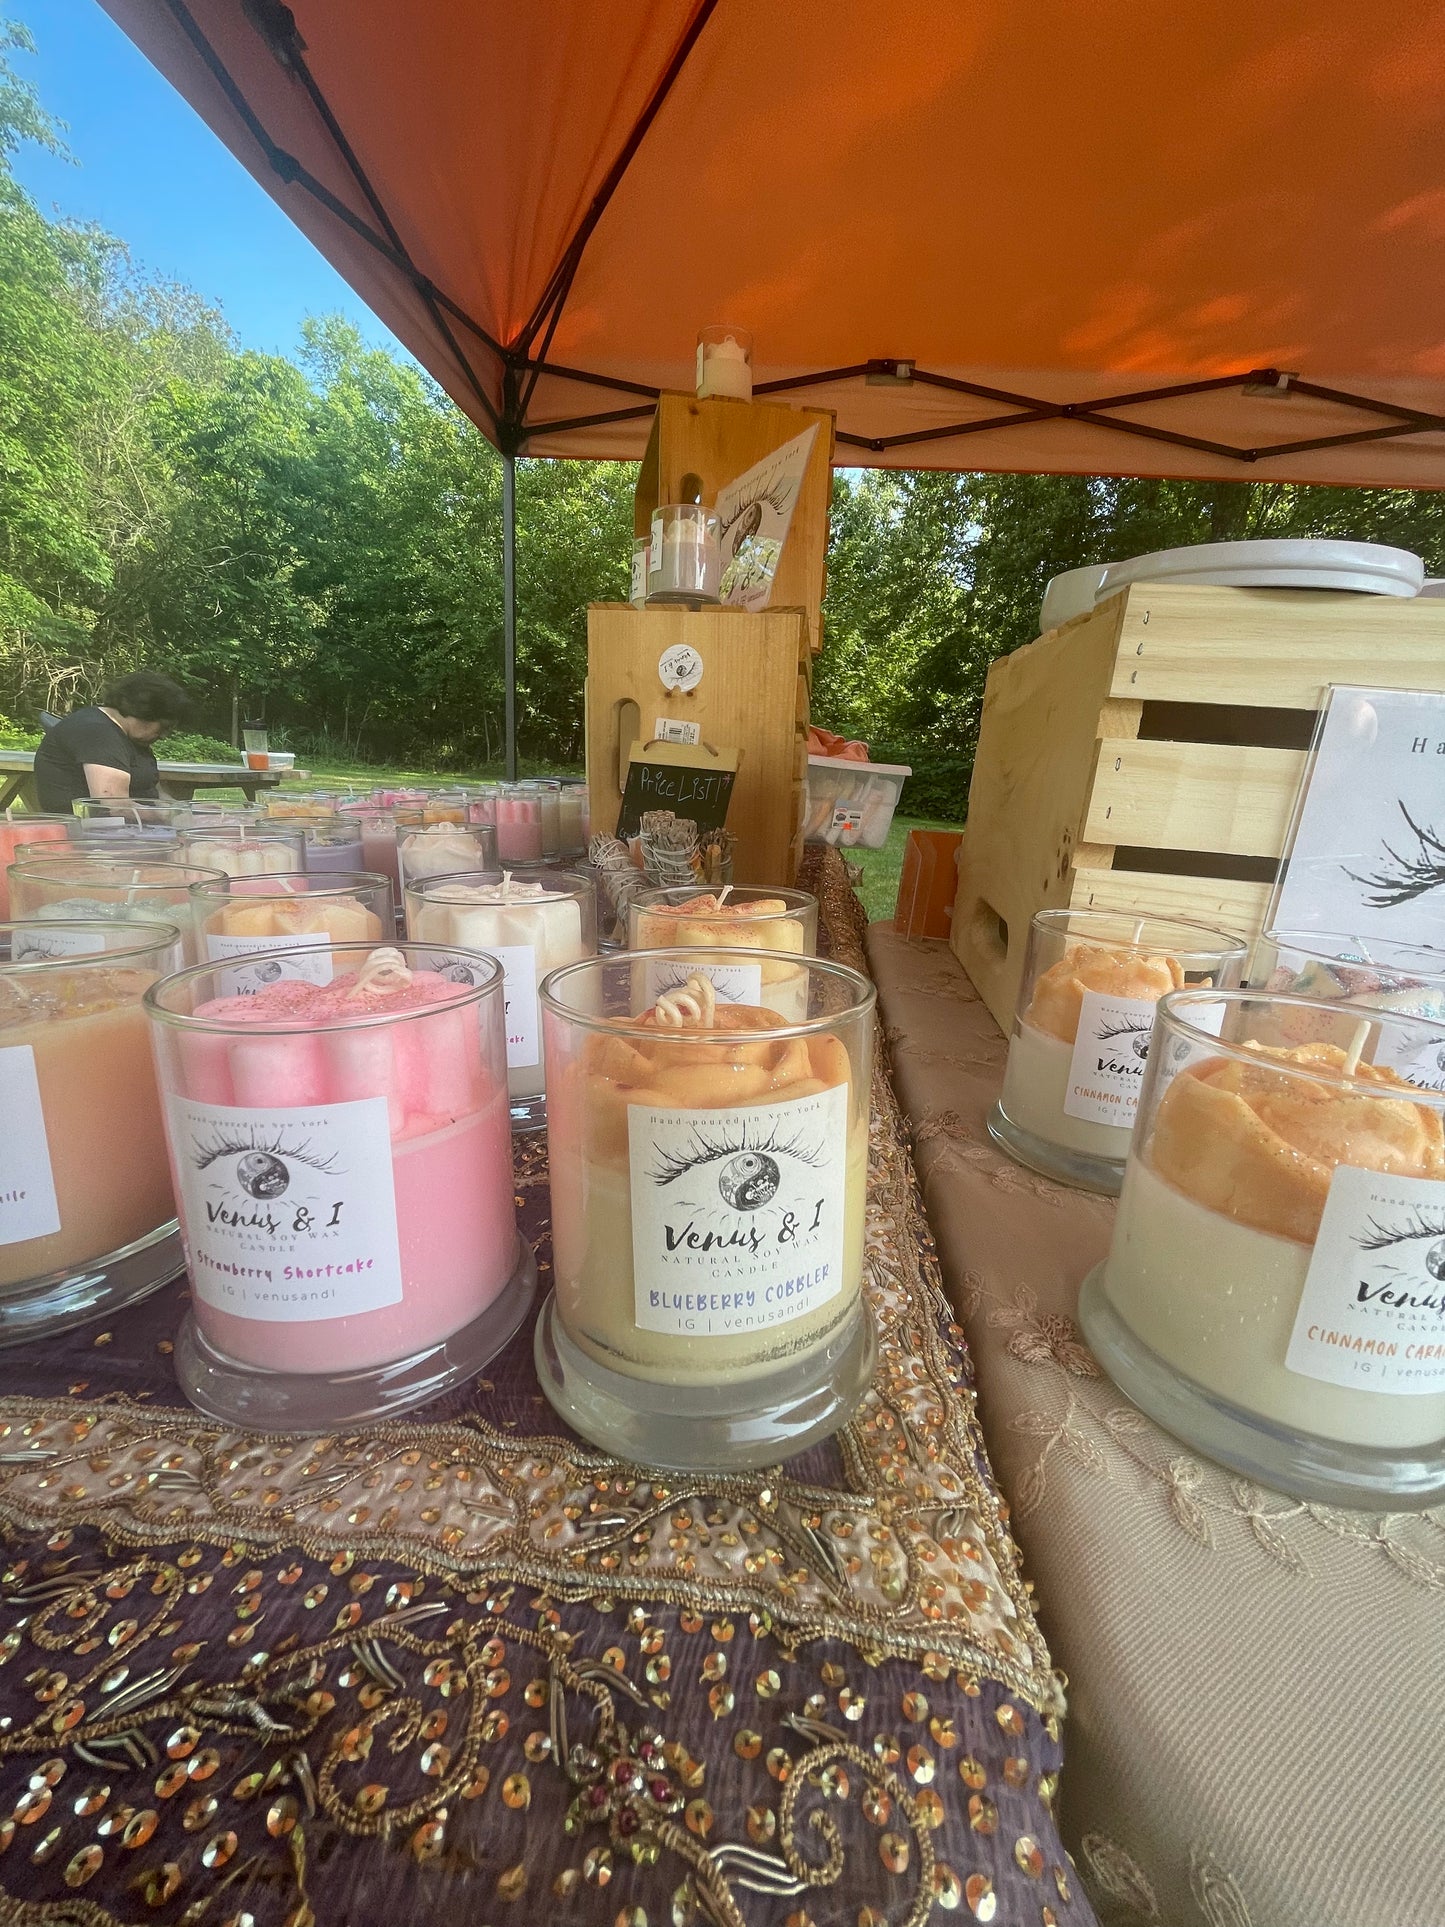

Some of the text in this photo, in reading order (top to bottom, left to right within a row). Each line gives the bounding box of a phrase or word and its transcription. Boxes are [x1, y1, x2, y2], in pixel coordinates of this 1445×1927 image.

[1411, 736, 1445, 755] Ha
[1097, 1057, 1146, 1076] Venu
[1073, 1085, 1122, 1105] CINNAMON
[206, 1201, 344, 1235] Venus & I
[665, 1198, 825, 1254] Venus & I
[197, 1249, 375, 1282] Strawberry Shortcake
[661, 1254, 742, 1265] NATURAL
[711, 1262, 779, 1279] CANDLE
[649, 1263, 831, 1312] BLUEBERRY COBBLER
[677, 1318, 696, 1330] IG
[1308, 1325, 1445, 1361] CINNAMON CARA
[1354, 1361, 1372, 1373] IG
